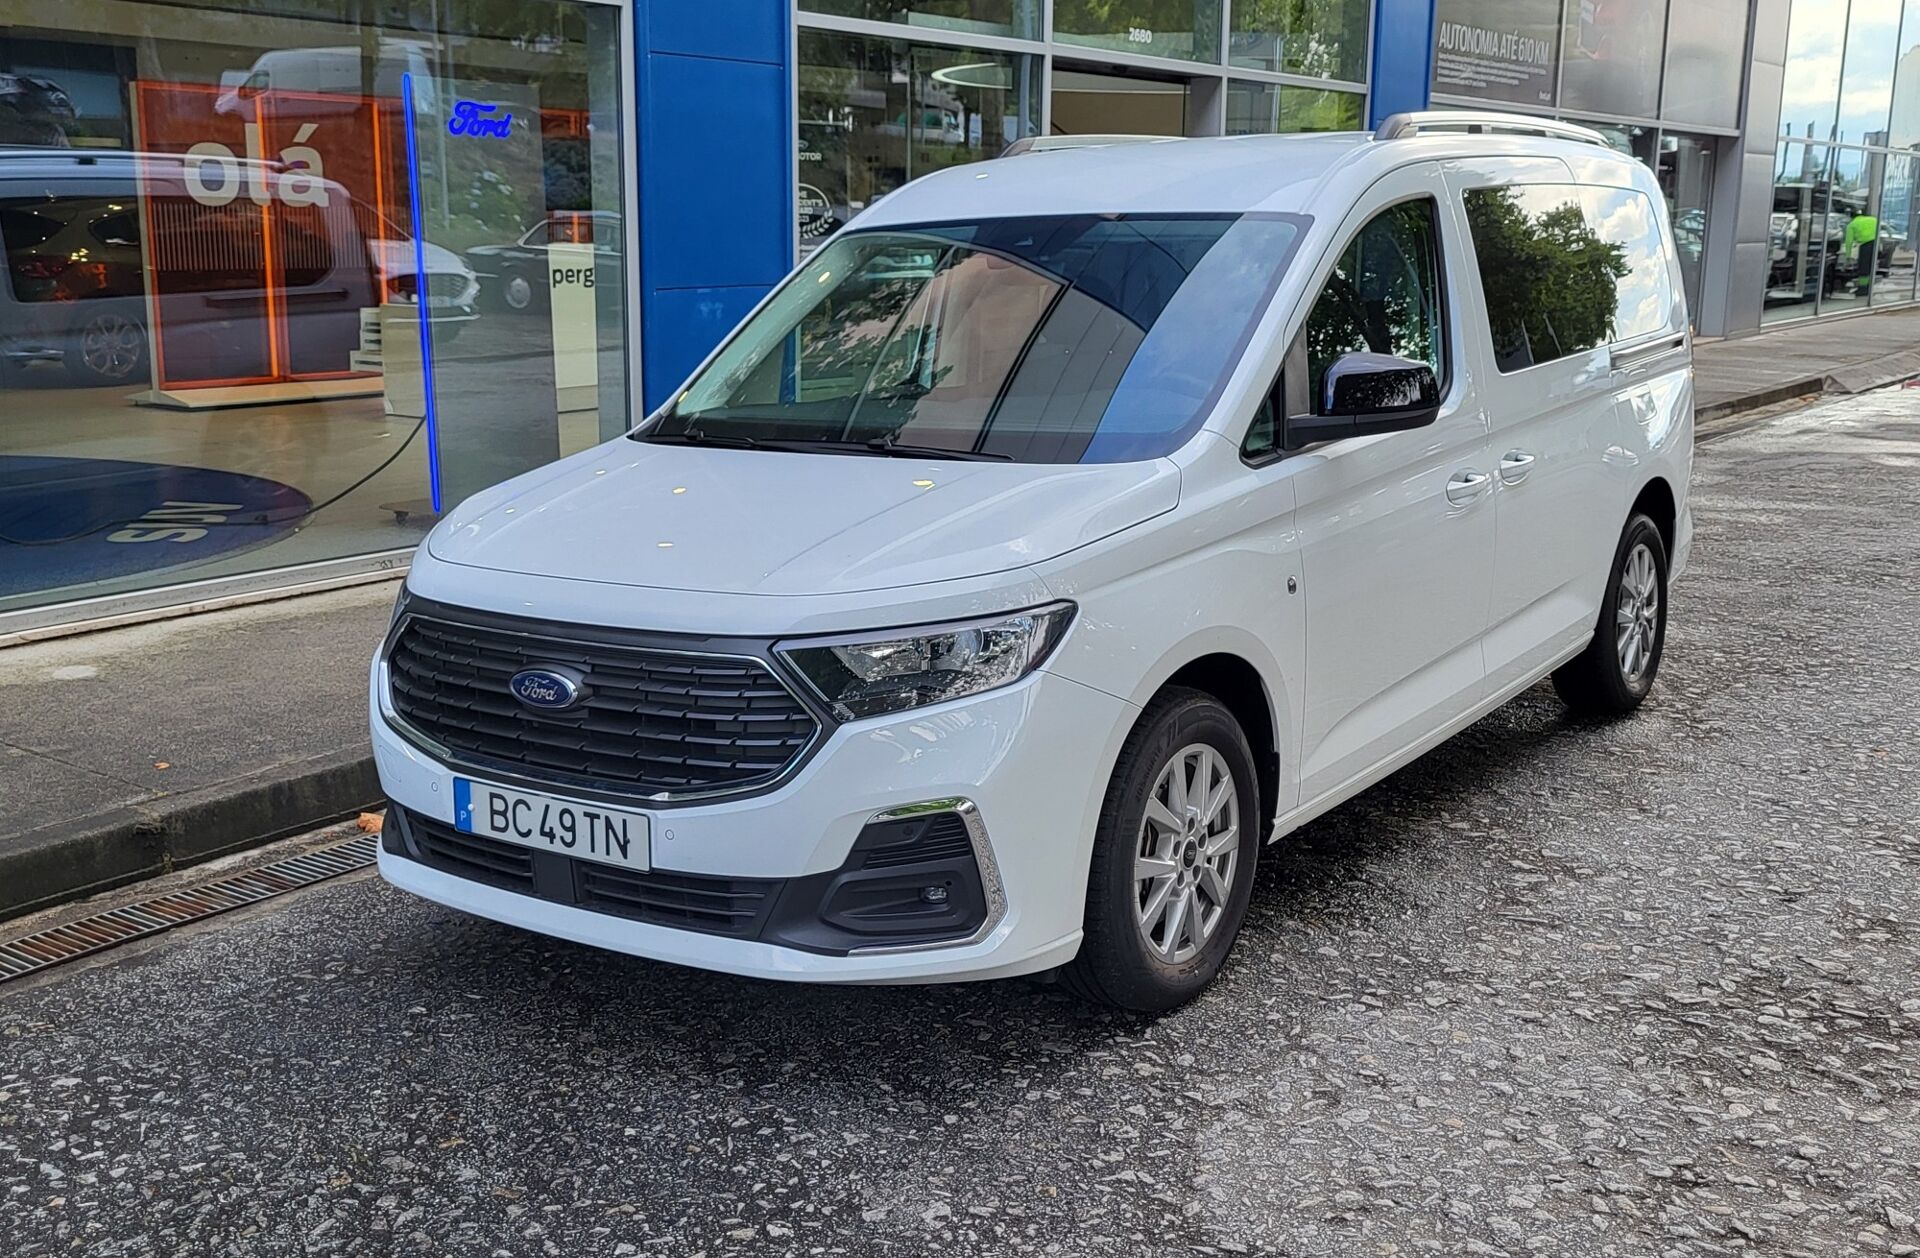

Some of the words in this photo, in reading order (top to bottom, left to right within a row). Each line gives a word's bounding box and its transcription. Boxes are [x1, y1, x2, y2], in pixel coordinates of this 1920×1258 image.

[1128, 27, 1152, 44] 2680
[1439, 21, 1499, 57] AUTONOMIA
[1500, 29, 1518, 60] ATÉ
[1518, 36, 1534, 63] 610
[1533, 40, 1550, 65] KM
[449, 100, 512, 139] Ford
[184, 123, 332, 208] olá
[799, 151, 822, 161] OTOR
[552, 267, 595, 288] perg
[520, 676, 558, 701] Ford
[460, 811, 467, 821] P
